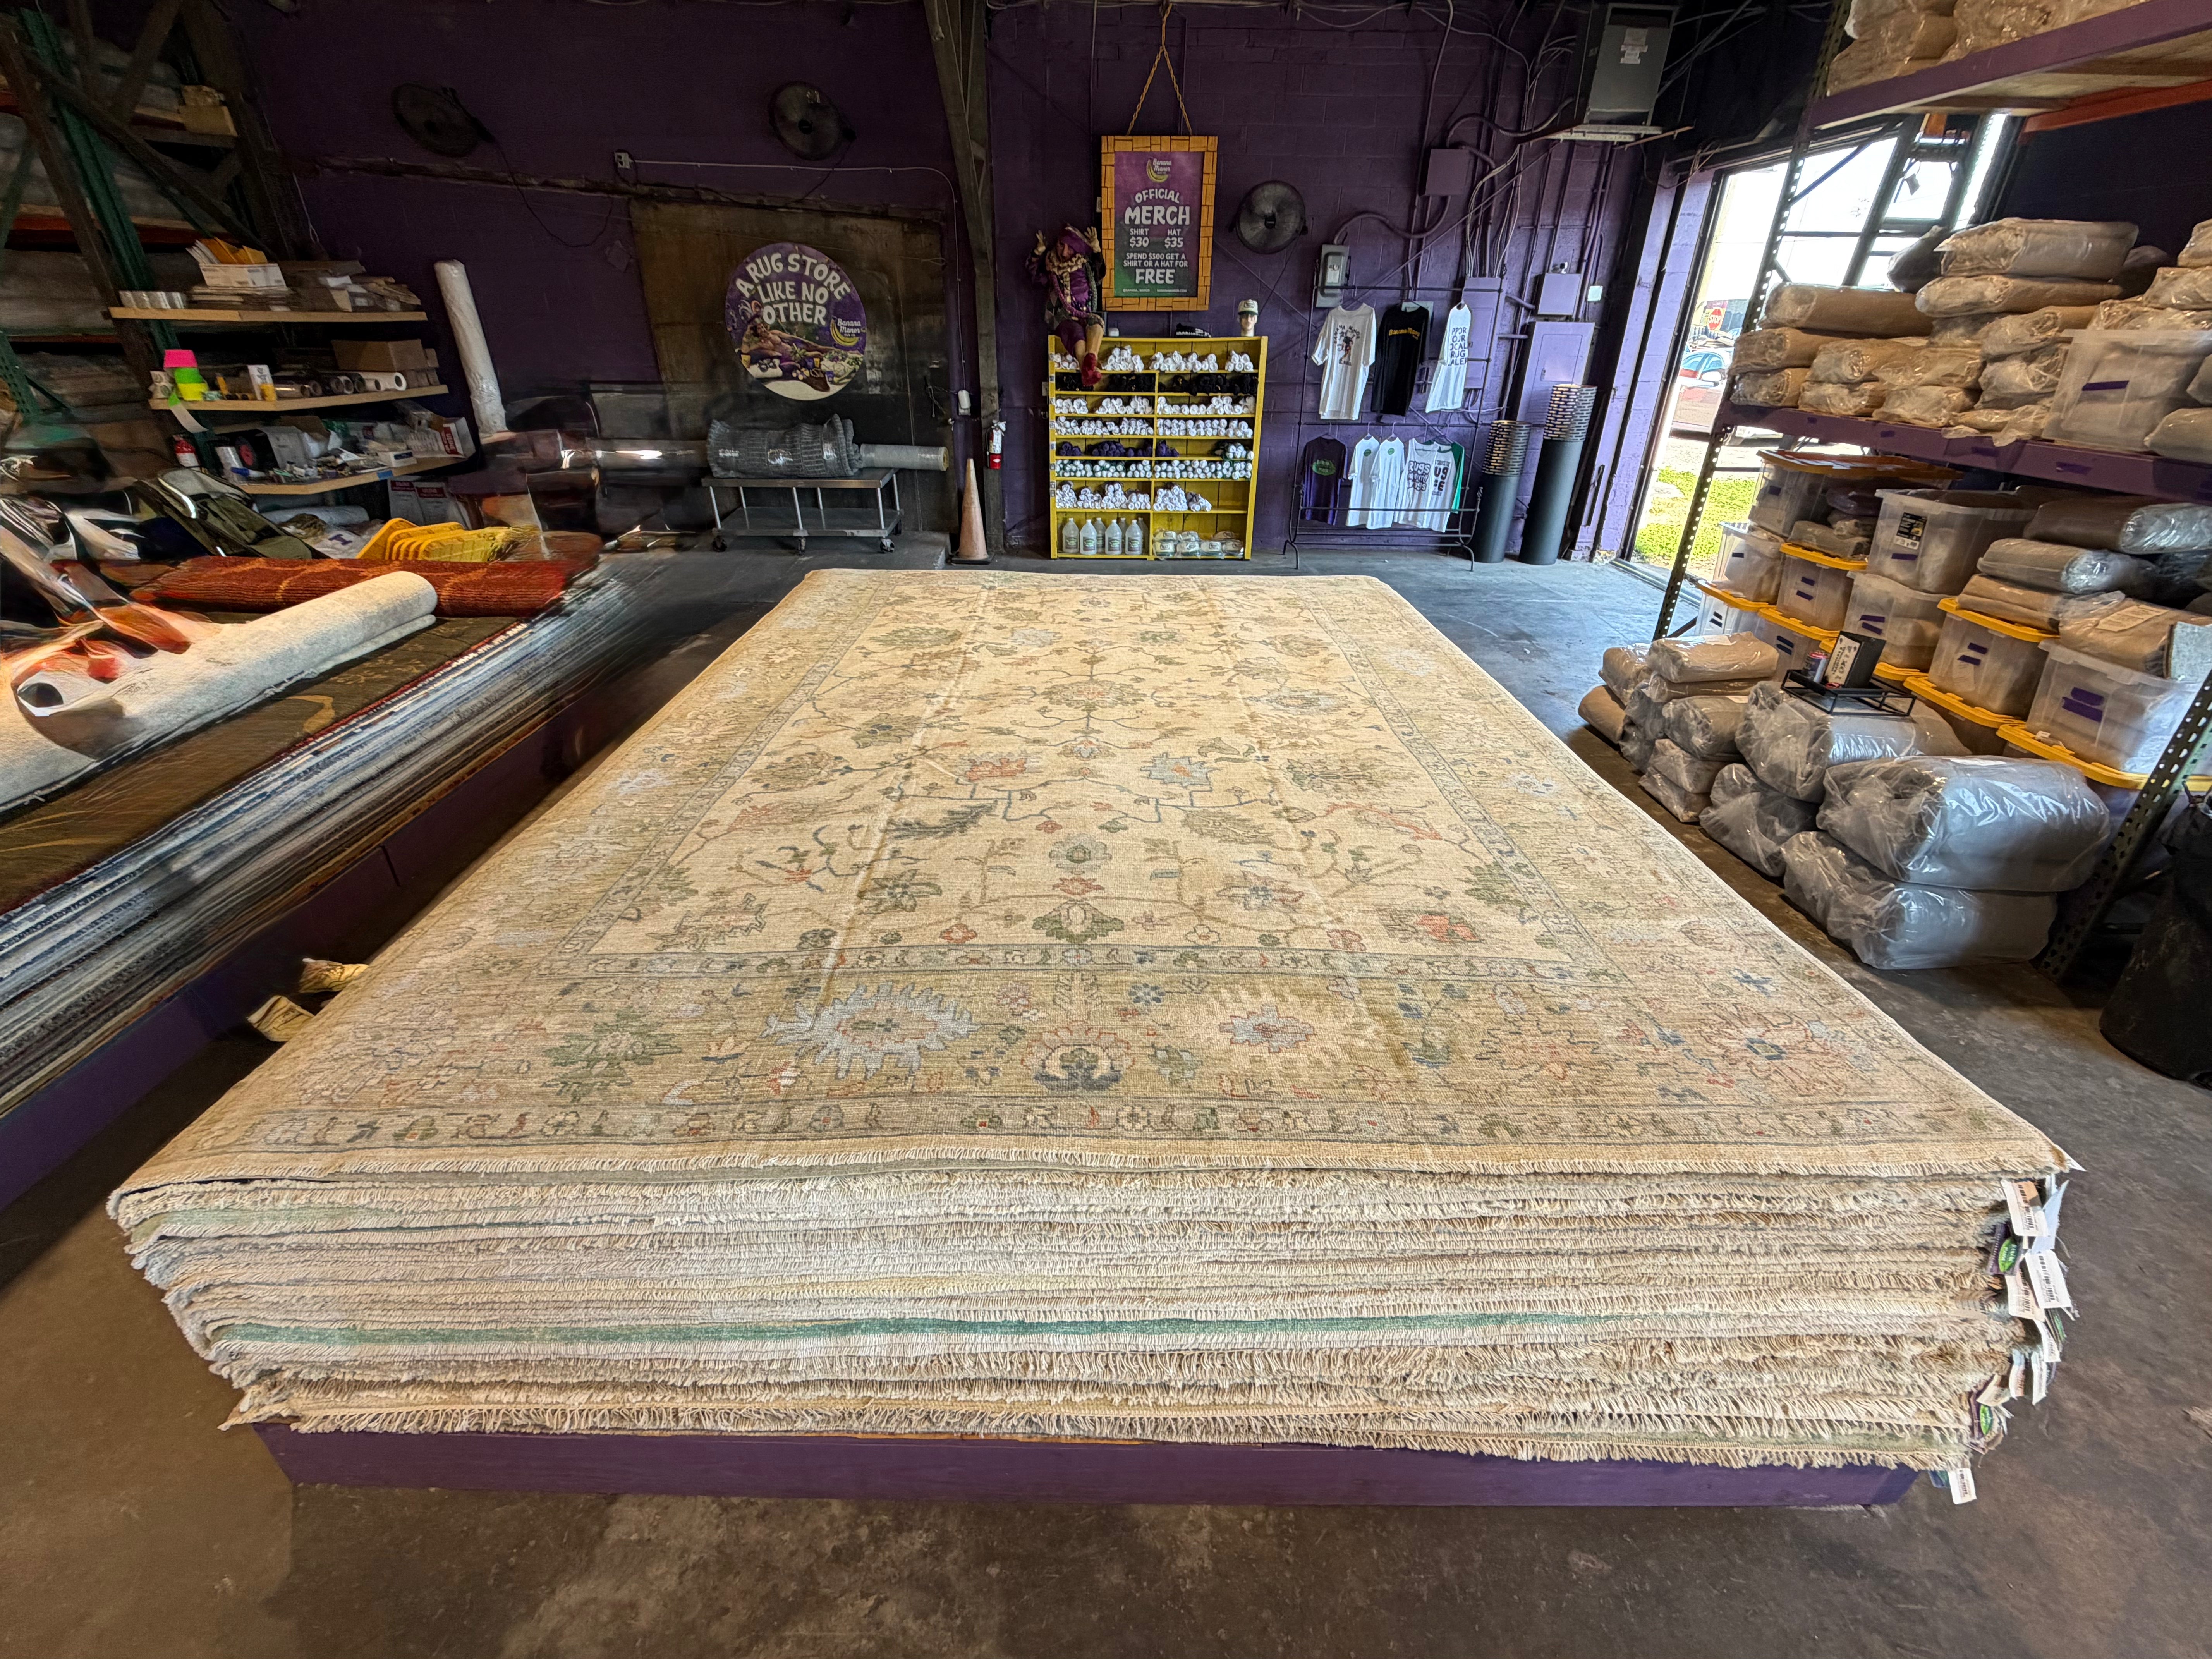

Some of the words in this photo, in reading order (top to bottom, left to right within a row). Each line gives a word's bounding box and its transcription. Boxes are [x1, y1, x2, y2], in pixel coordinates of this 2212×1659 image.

[1135, 188, 1180, 204] OFFICIAL
[1125, 206, 1190, 225] MERCH
[1130, 236, 1149, 248] $30
[1164, 237, 1183, 249] $35
[735, 278, 754, 299] A
[746, 253, 783, 283] RUG
[788, 253, 851, 300] STORE
[1135, 268, 1176, 284] FREE
[756, 281, 797, 303] LIKE
[802, 282, 829, 304] NO
[762, 302, 827, 326] OTHER
[1708, 315, 1722, 324] STOP
[837, 318, 861, 326] Banana
[840, 326, 860, 334] Manor
[1451, 326, 1467, 335] PPOR
[1452, 335, 1466, 343] OUR
[1449, 343, 1468, 351] OCAL
[1451, 350, 1466, 358] RUG
